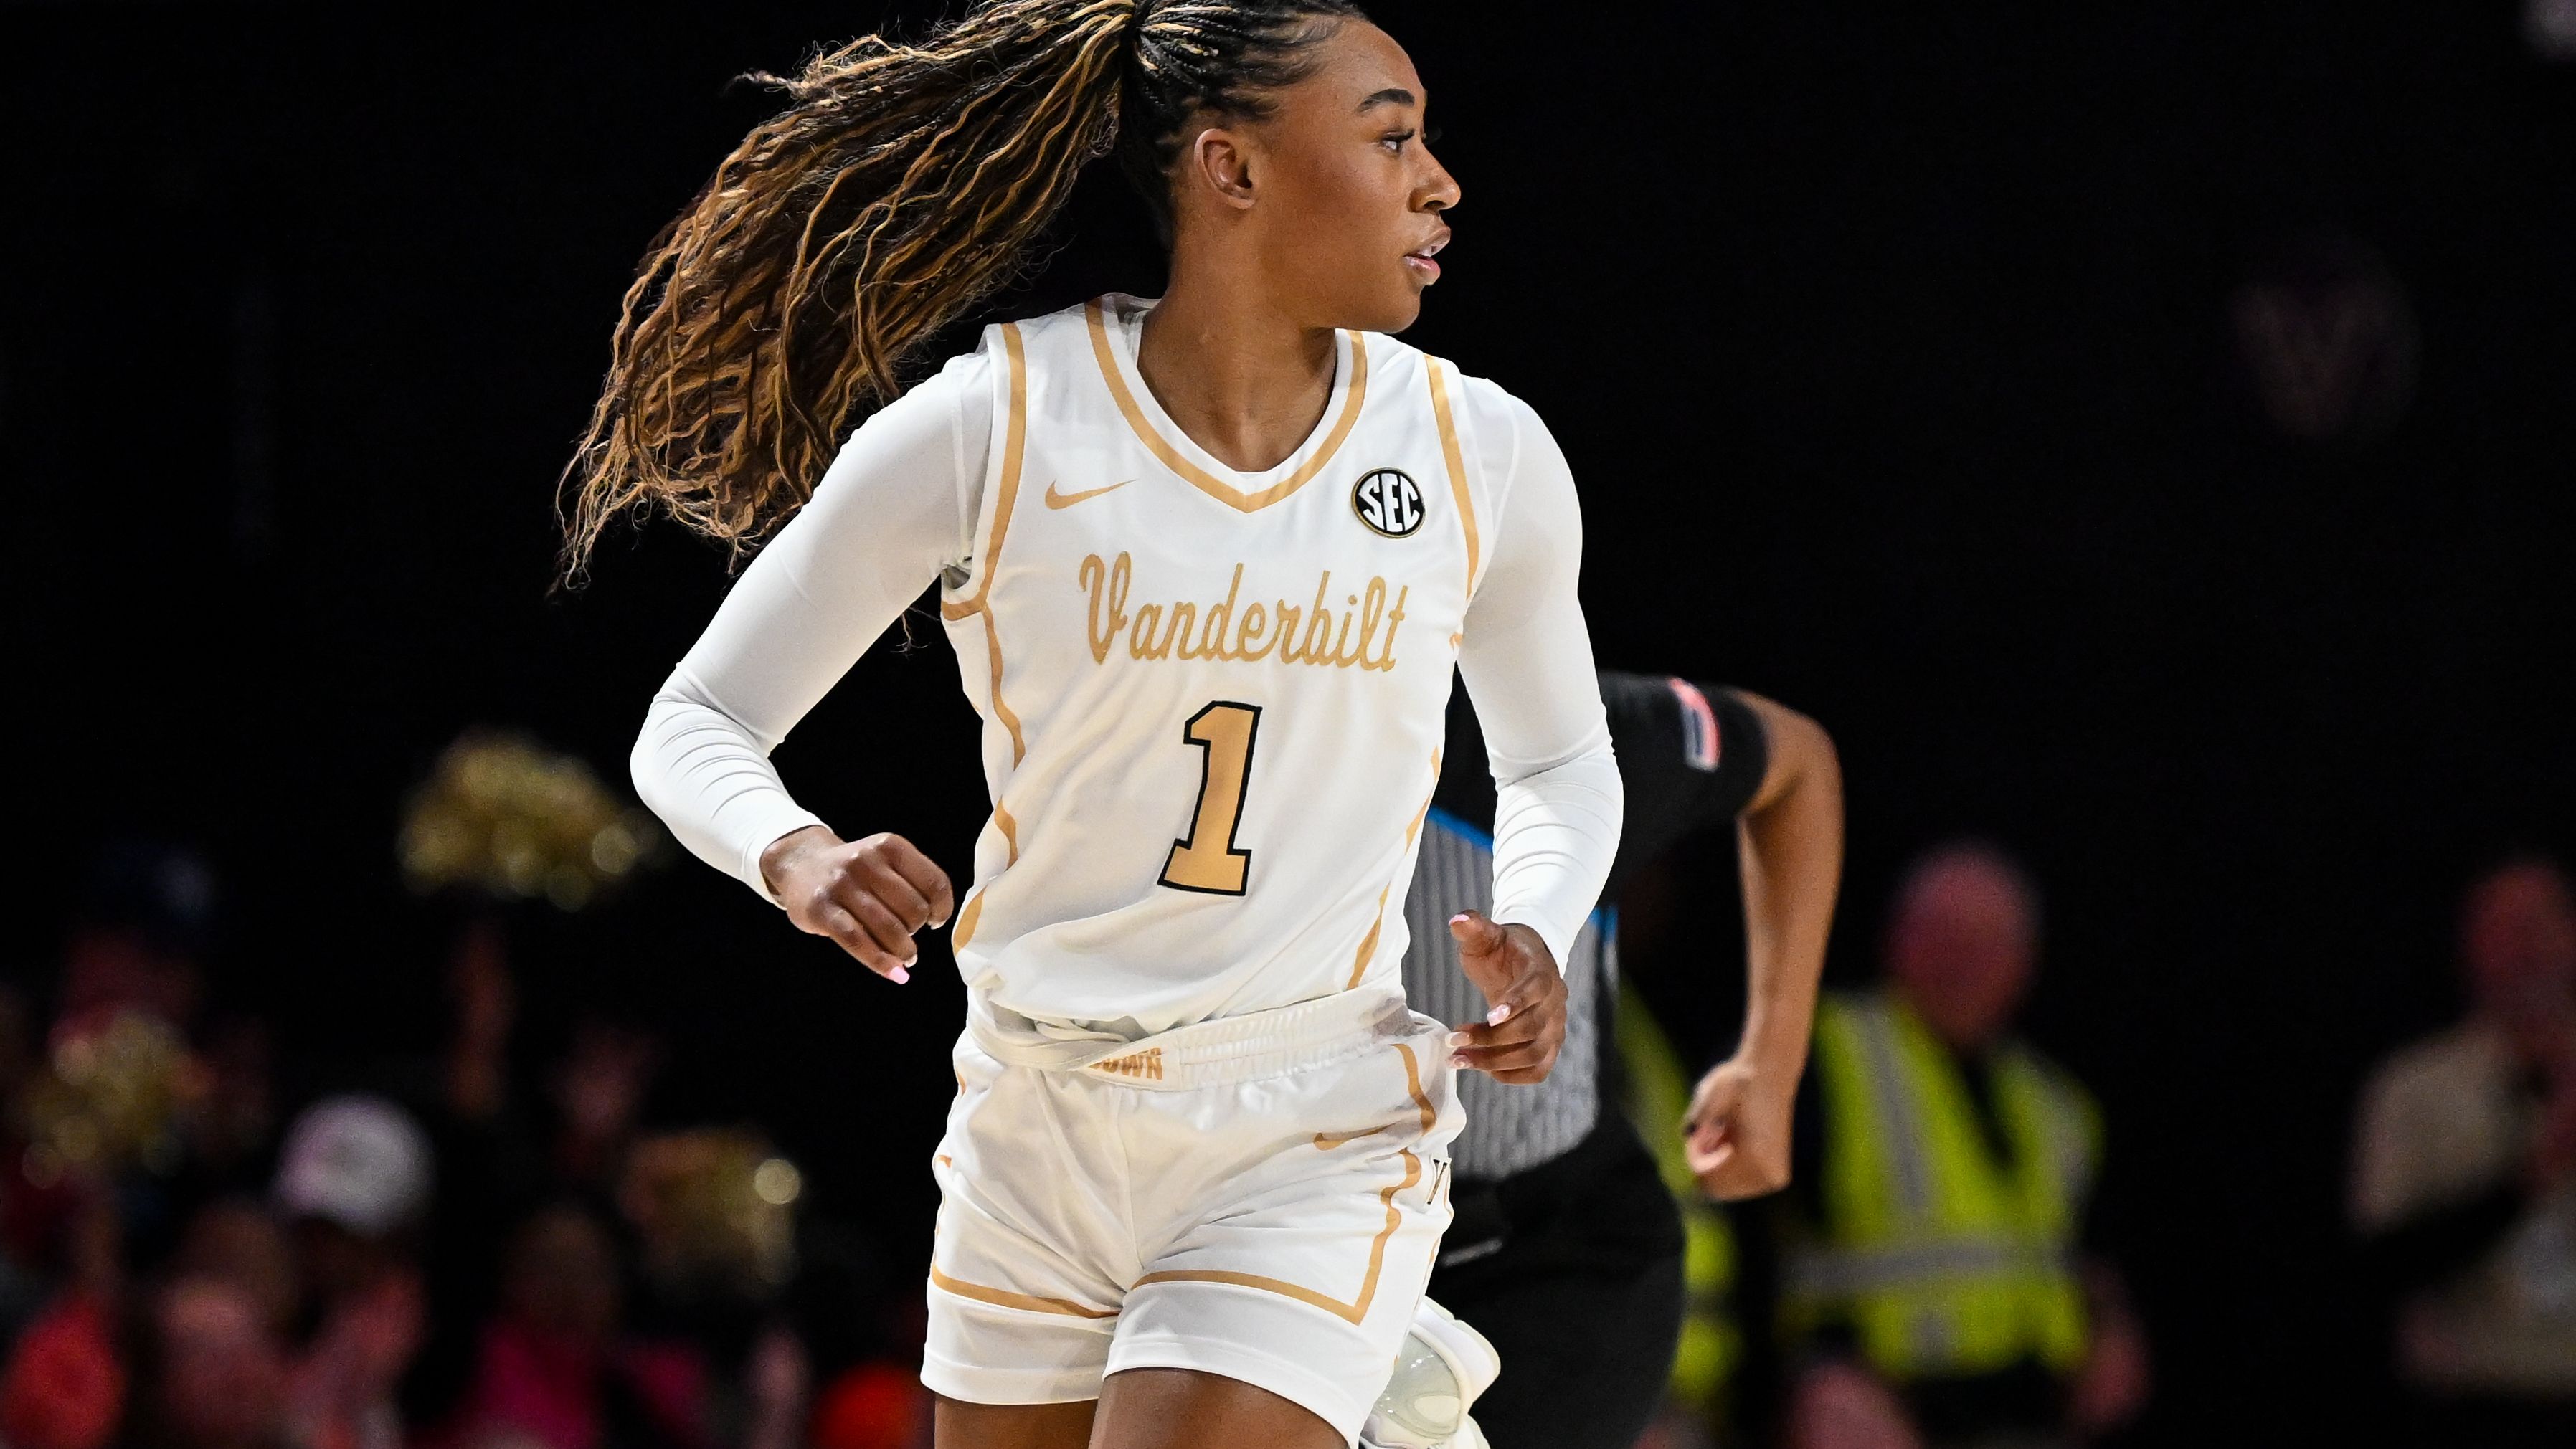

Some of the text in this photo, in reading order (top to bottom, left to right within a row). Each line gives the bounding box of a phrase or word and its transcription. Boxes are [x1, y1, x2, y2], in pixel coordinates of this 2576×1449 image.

[1358, 472, 1424, 533] SEC
[1080, 551, 1408, 672] Vanderbilt
[1157, 700, 1262, 896] 1
[1089, 1047, 1162, 1080] OWN
